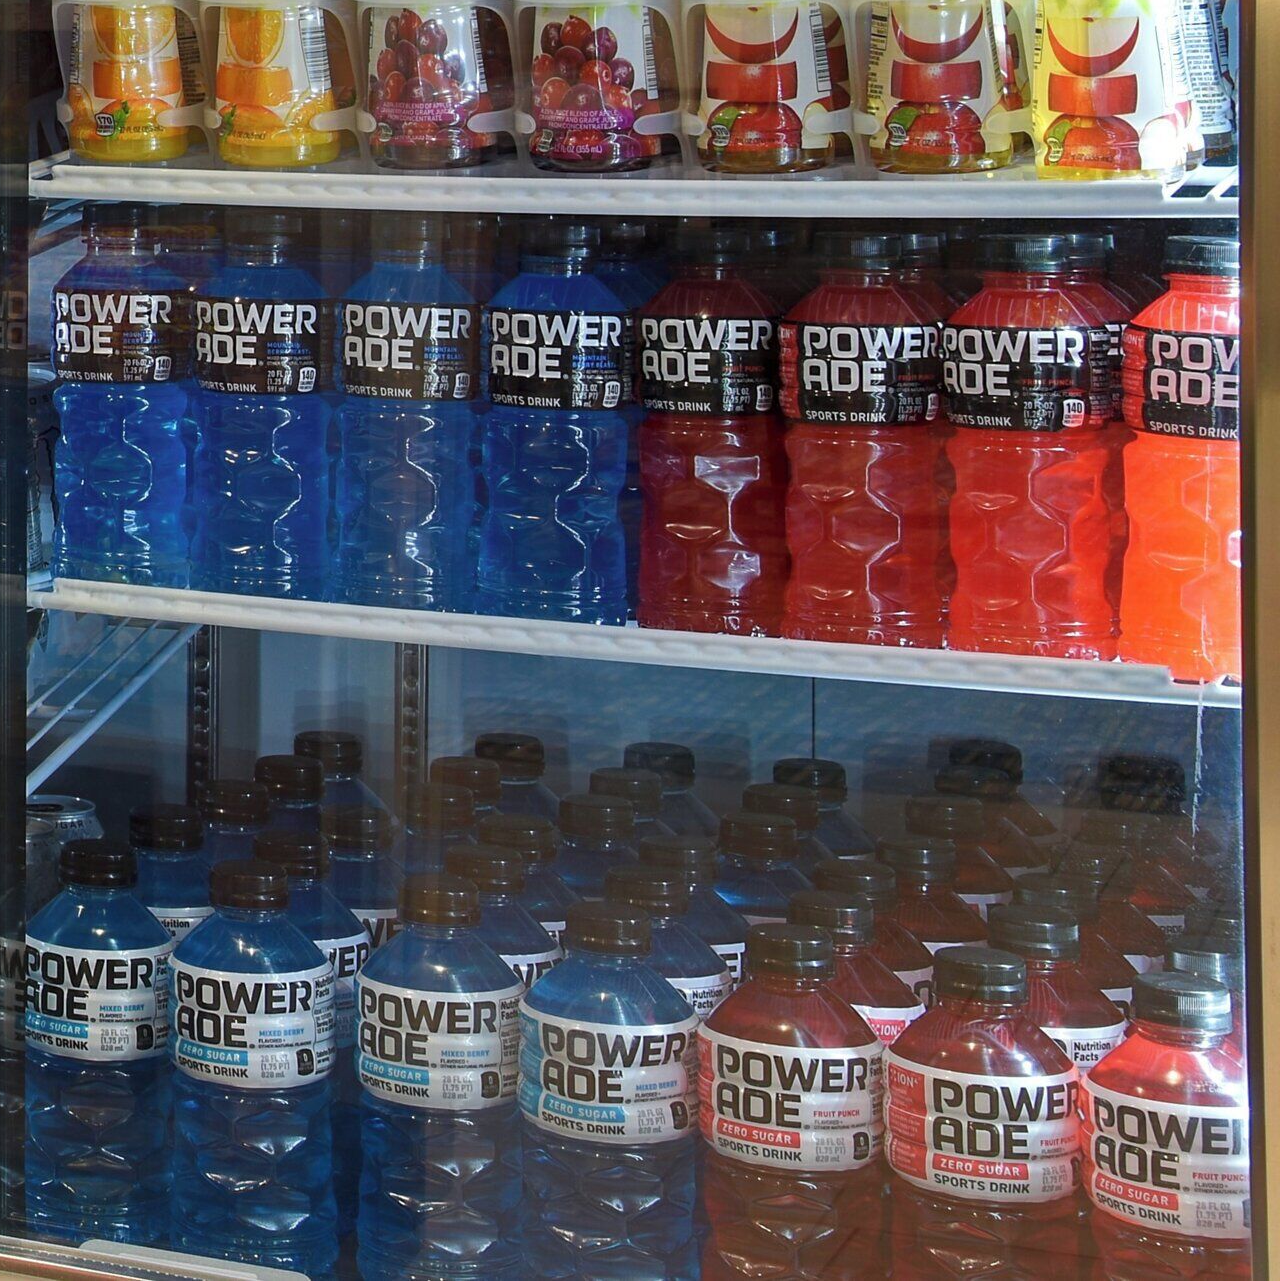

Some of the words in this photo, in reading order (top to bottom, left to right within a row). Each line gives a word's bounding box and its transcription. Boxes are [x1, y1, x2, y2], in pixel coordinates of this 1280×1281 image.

[97, 115, 112, 126] 170
[196, 301, 317, 334] POWER
[641, 318, 772, 351] POWER
[944, 324, 1085, 365] POWER
[197, 334, 257, 366] ADE
[642, 350, 712, 383] ADE
[944, 363, 1011, 396] ADE
[1066, 402, 1083, 414] 140
[1150, 421, 1195, 436] SPORTS
[1199, 426, 1238, 439] DRINK
[693, 988, 723, 1001] Nutrition
[693, 999, 714, 1010] Facts
[259, 1029, 281, 1037] MIXED
[283, 1028, 305, 1036] BERRY
[440, 1050, 464, 1058] MIXED
[466, 1050, 490, 1058] BERRY
[361, 1072, 393, 1094] SPORTS
[395, 1084, 429, 1098] DRINK
[813, 1110, 833, 1118] FRUIT
[836, 1109, 860, 1118] PUNCH
[940, 1158, 973, 1173] ZERO
[976, 1163, 1020, 1178] SUGAR
[934, 1173, 983, 1192] SPORTS
[984, 1179, 1030, 1195] DRINK
